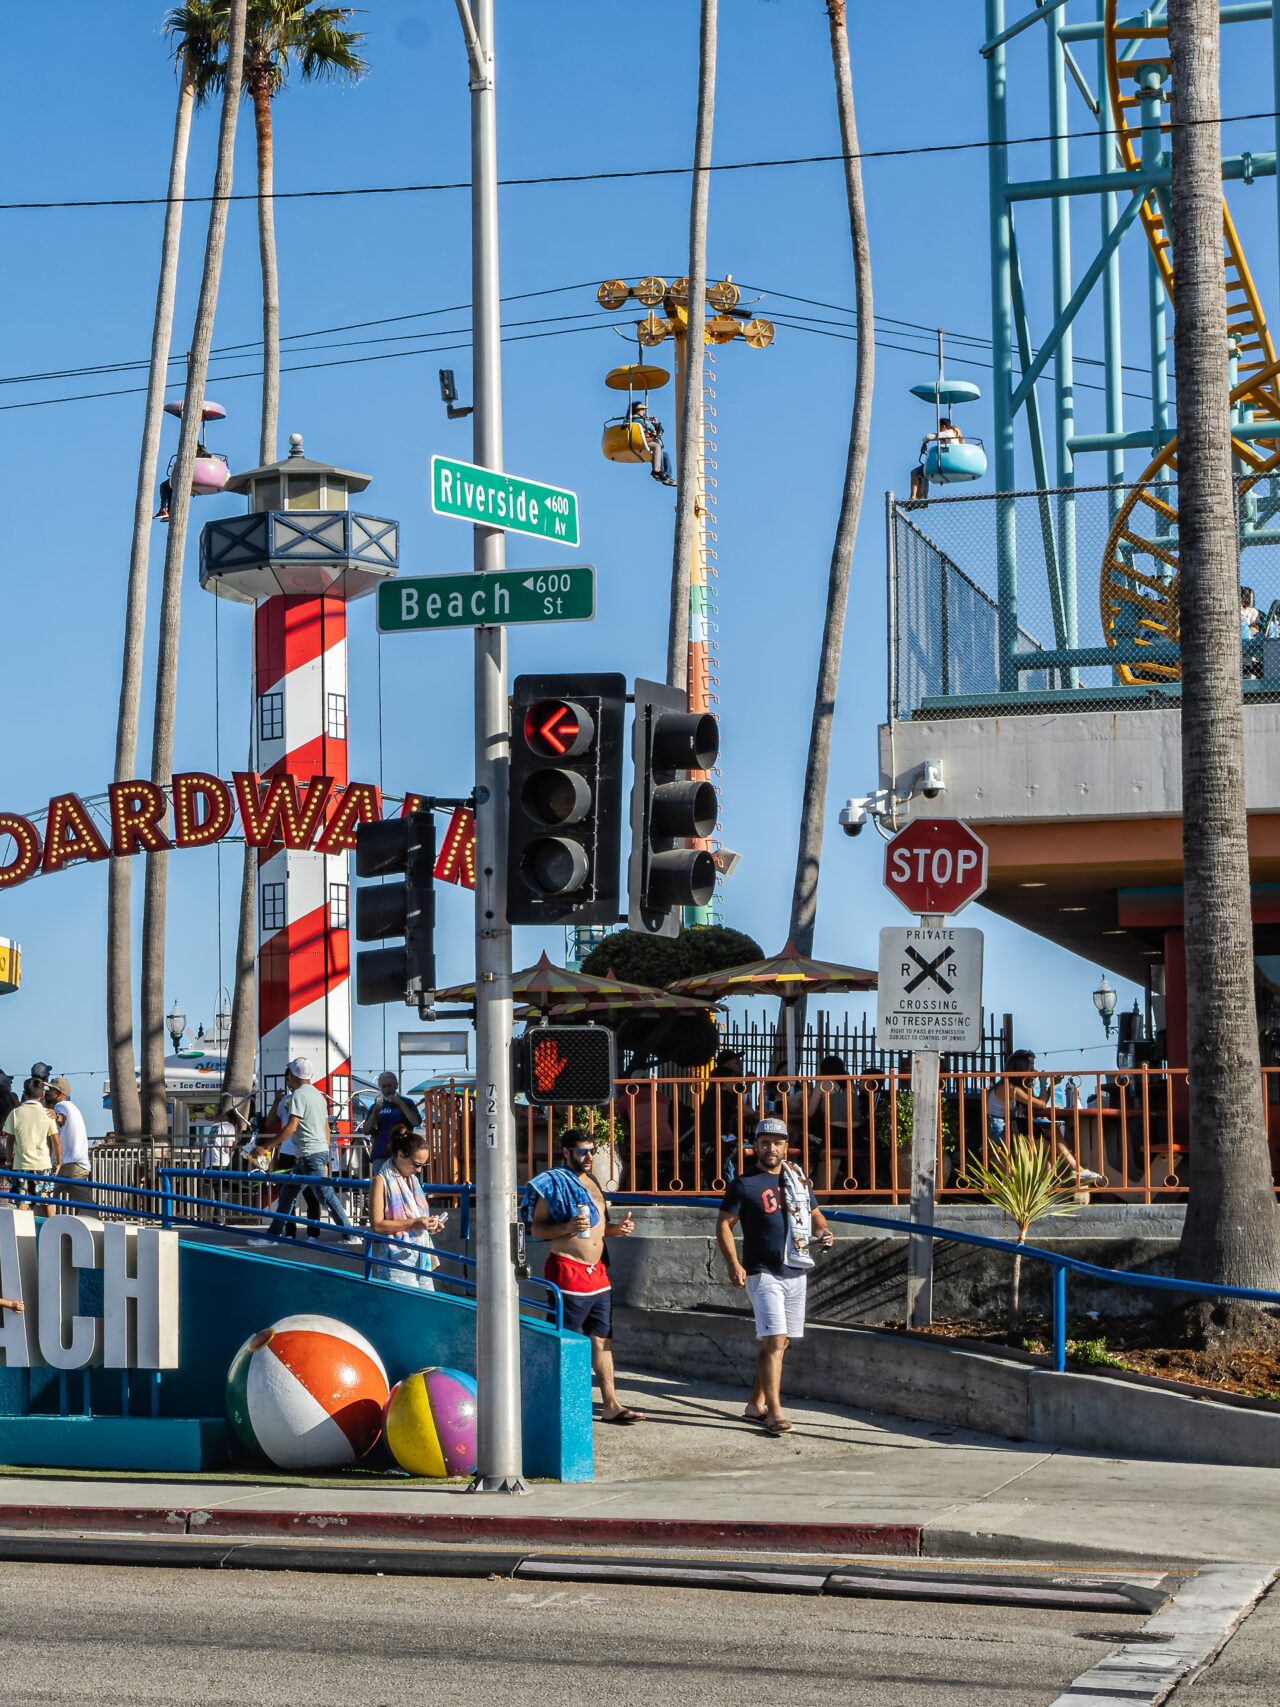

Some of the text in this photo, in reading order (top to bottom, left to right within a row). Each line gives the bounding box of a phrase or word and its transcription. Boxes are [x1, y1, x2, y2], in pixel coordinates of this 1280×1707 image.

[440, 468, 569, 525] Riverside 600
[554, 517, 567, 536] Av
[401, 574, 571, 620] Beach 600
[543, 597, 564, 615] St
[891, 847, 978, 884] STOP
[906, 930, 955, 940] PRIVATE
[901, 963, 957, 977] R R
[899, 1000, 958, 1010] CROSSING
[885, 1015, 971, 1027] NO TRESPASSING
[179, 1082, 194, 1090] Ice
[487, 1083, 497, 1147] 721
